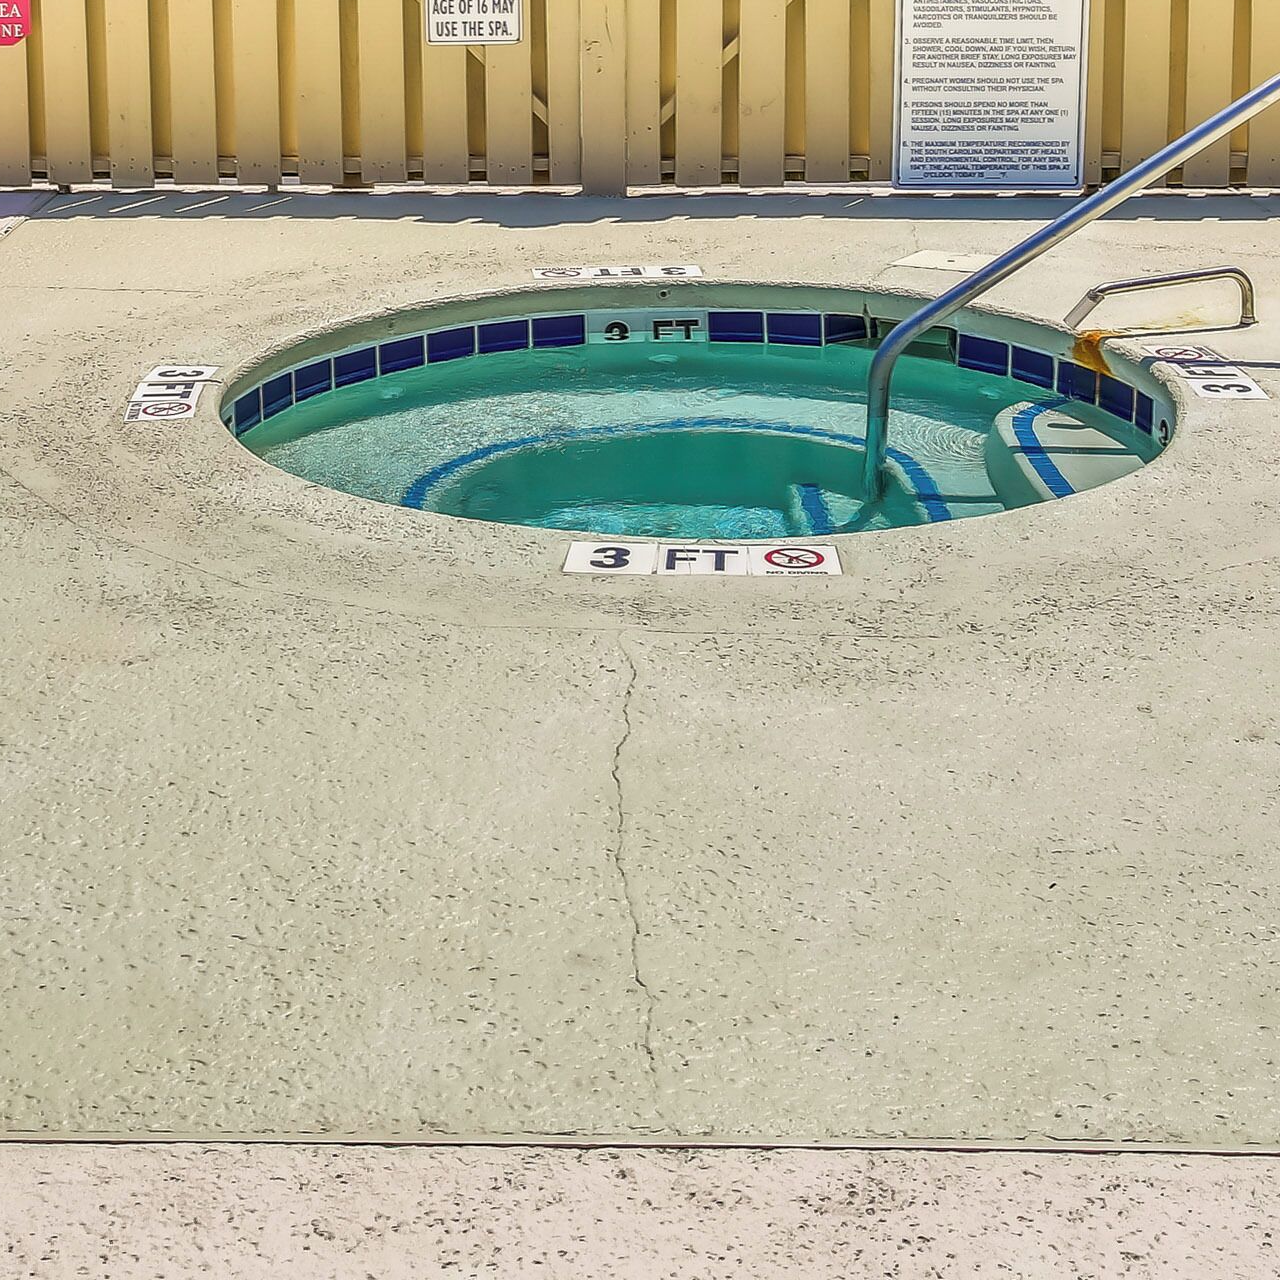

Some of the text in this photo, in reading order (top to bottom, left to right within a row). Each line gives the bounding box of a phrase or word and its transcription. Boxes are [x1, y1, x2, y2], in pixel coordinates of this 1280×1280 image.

[432, 0, 455, 15] AGE
[459, 0, 473, 14] OF
[477, 0, 488, 14] 16
[436, 21, 512, 37] USE THE SPA.
[652, 319, 700, 341] FT
[589, 547, 739, 572] 3 FT
